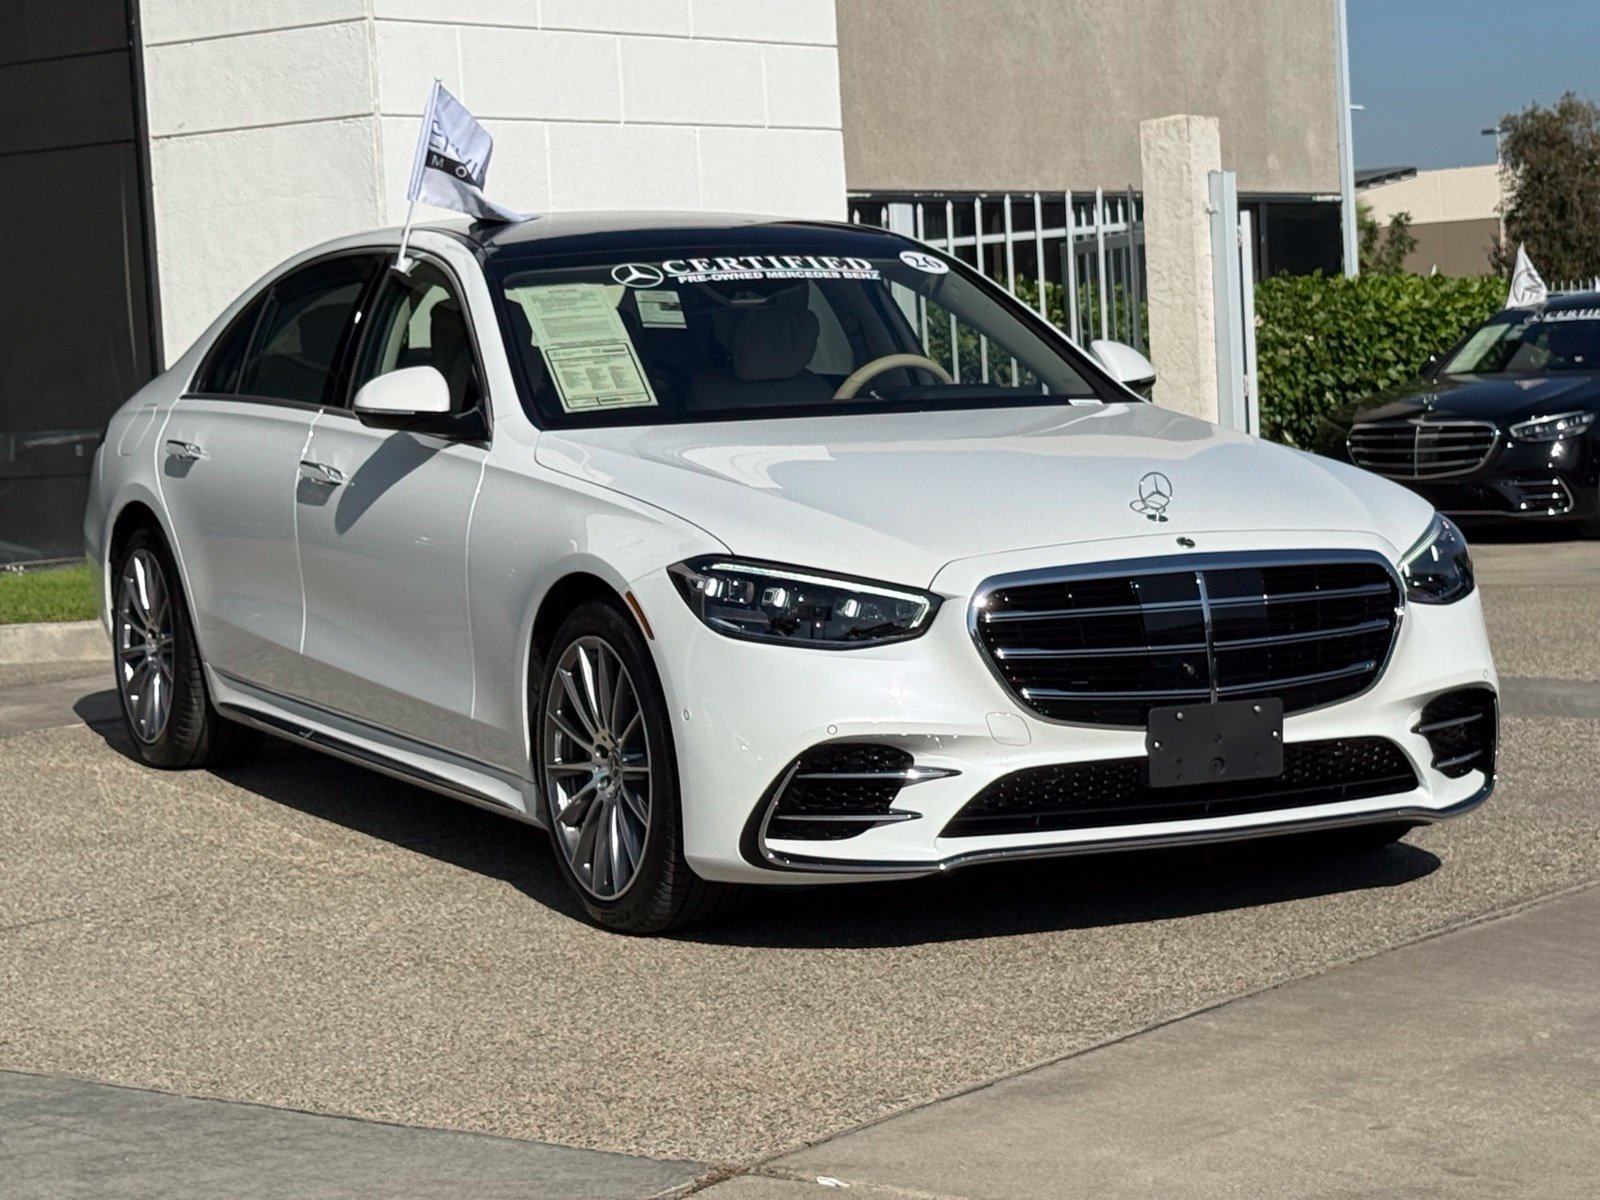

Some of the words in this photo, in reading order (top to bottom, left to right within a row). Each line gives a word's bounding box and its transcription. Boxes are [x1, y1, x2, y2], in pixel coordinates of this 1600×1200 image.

[662, 255, 872, 274] CERTIFIED
[678, 272, 763, 284] PRE-OWNED
[766, 270, 841, 279] MERCEDES
[843, 271, 881, 281] BENZ
